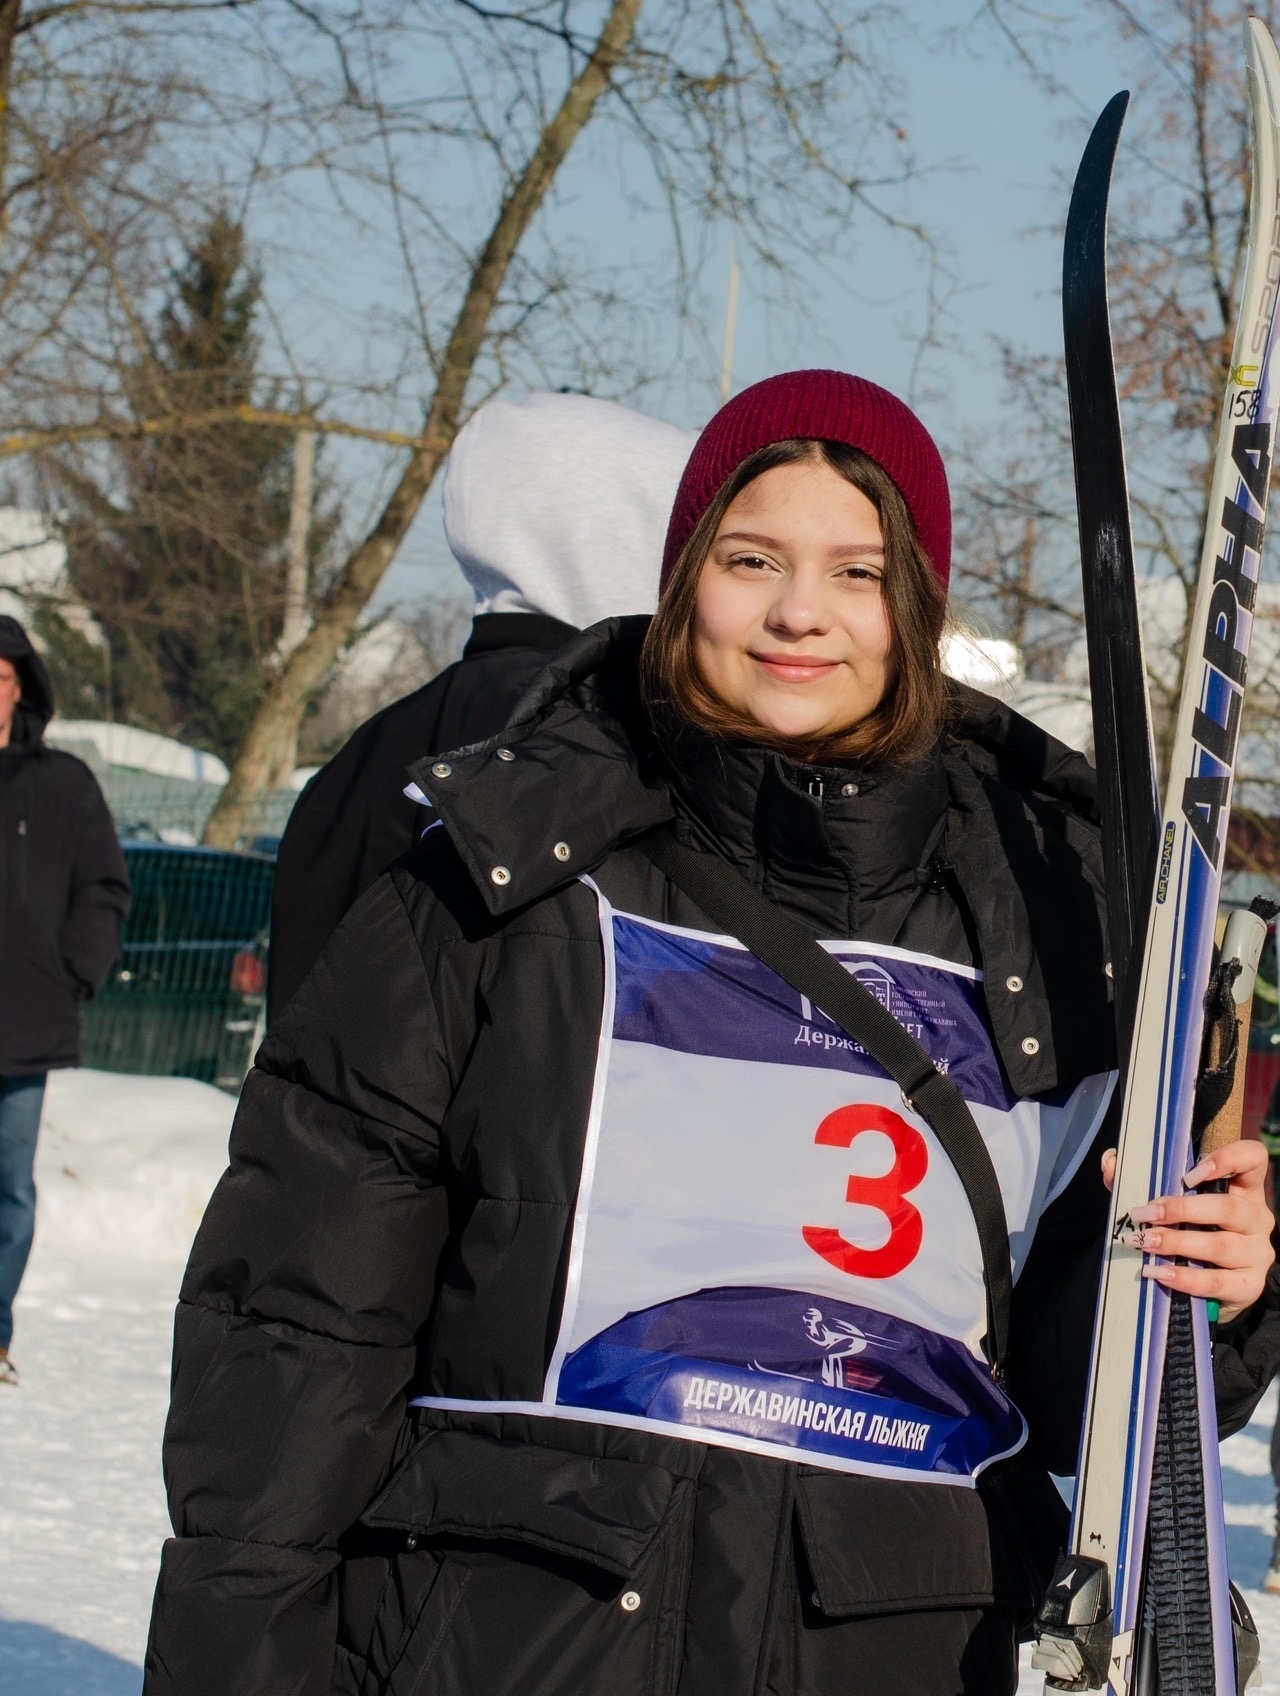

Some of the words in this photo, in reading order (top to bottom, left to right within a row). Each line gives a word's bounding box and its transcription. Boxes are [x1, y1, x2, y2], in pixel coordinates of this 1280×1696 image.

[1228, 390, 1262, 419] 158
[1181, 422, 1271, 873] ALPHA
[1161, 823, 1175, 878] CHANEL
[801, 1103, 929, 1279] 3
[683, 1376, 867, 1440] ДЕРЖАВИНСКАЯ
[864, 1414, 931, 1451] ЛЫЖНЯ
